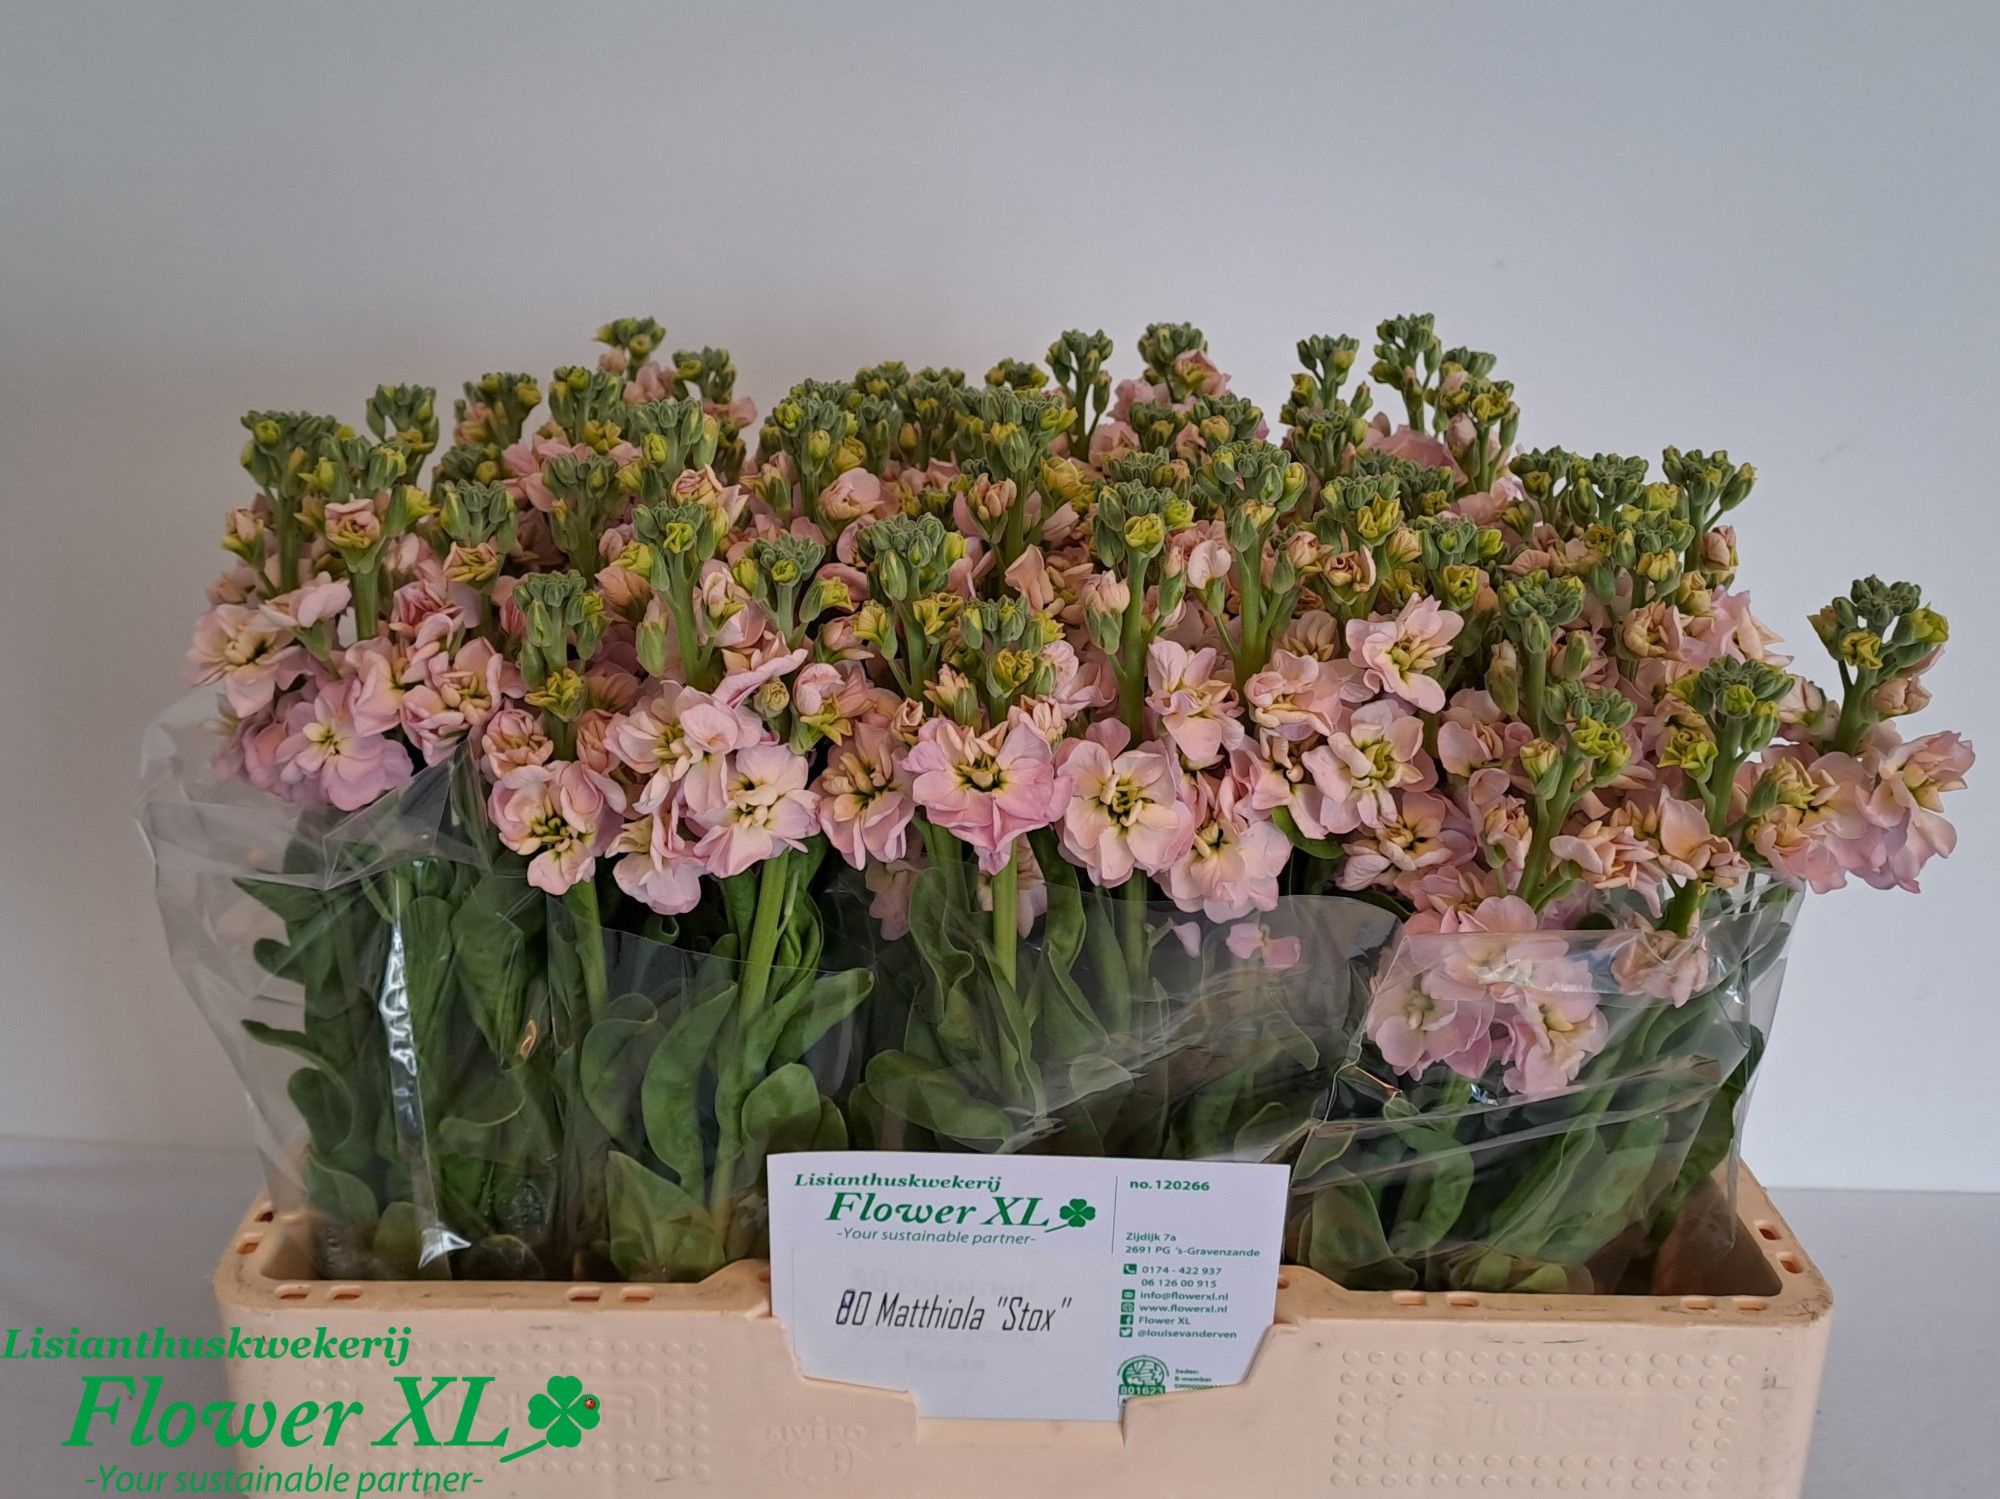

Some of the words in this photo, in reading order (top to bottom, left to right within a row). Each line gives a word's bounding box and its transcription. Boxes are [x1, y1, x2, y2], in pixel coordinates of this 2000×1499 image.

[794, 1173, 1002, 1192] Lisianthuskwekerij
[1130, 1180, 1152, 1189] no.
[1156, 1180, 1210, 1191] 120266
[825, 1192, 976, 1225] Flower
[980, 1196, 1049, 1227] XL
[881, 1229, 969, 1244] sustainable
[1126, 1232, 1160, 1242] Zijdijk
[1164, 1233, 1176, 1242] 7a
[1125, 1245, 1151, 1254] 2691
[1155, 1246, 1171, 1255] PG
[1142, 1266, 1169, 1274] 0174
[1179, 1267, 1199, 1275] 422
[1202, 1267, 1222, 1275] 937
[1141, 1279, 1155, 1287] 06
[1159, 1279, 1178, 1287] 126
[1181, 1279, 1194, 1287] 00
[1197, 1280, 1217, 1288] 915
[1140, 1291, 1229, 1301] info@flowerxl.nl
[836, 1289, 872, 1326] 80
[876, 1292, 985, 1330] Matthiola
[1139, 1304, 1227, 1313] www.flowerxl.nl
[1139, 1316, 1175, 1324] Flower
[1178, 1317, 1191, 1325] XL
[1138, 1328, 1237, 1338] @louisevanderven
